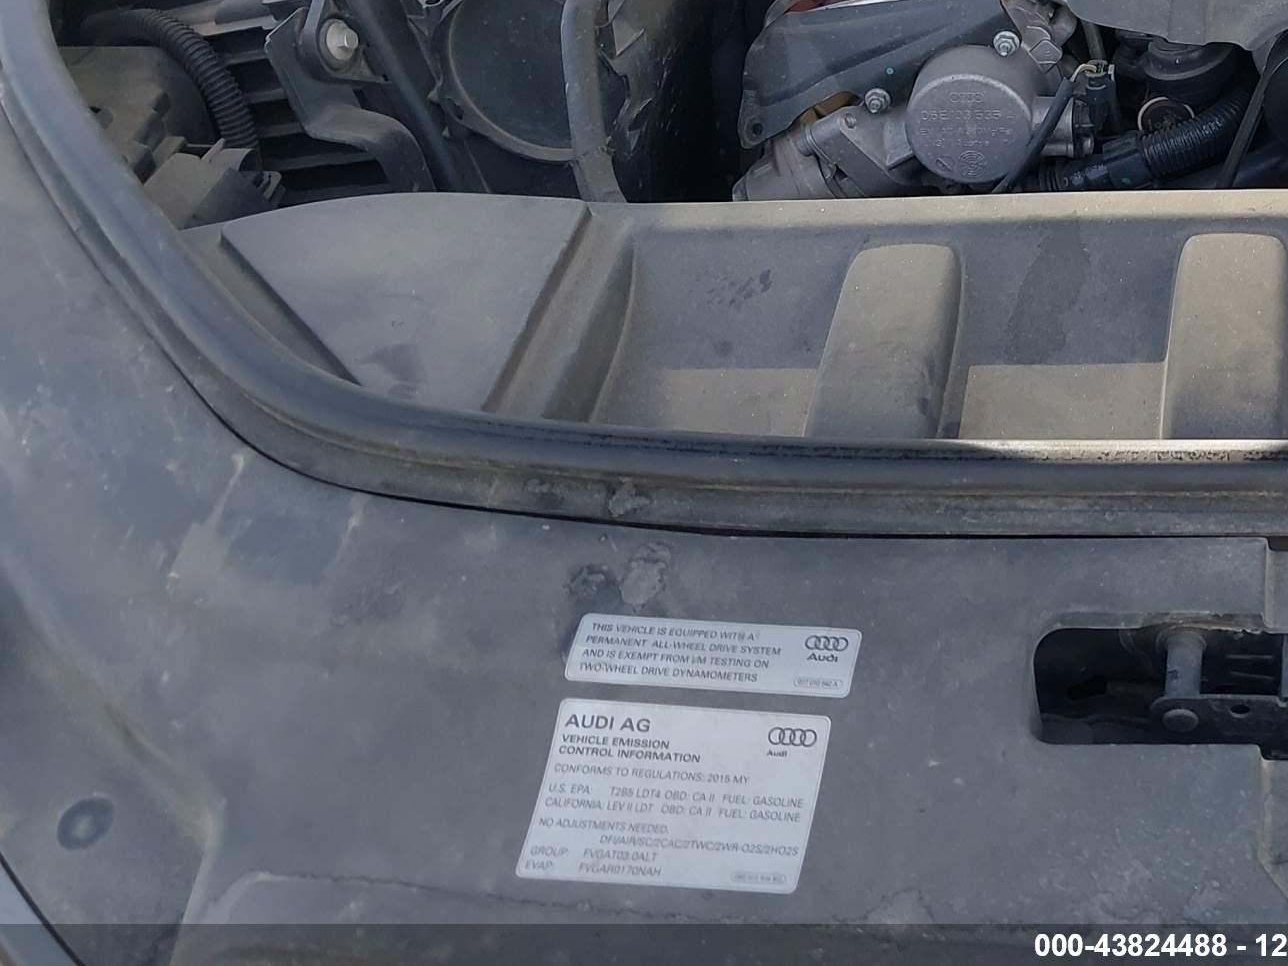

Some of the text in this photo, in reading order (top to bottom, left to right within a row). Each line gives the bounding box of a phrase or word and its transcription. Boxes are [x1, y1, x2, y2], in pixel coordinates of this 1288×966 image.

[592, 622, 614, 632] THIS
[616, 624, 656, 635] VEHICLE
[657, 627, 667, 636] IS
[669, 628, 718, 639] EQUIPPED
[720, 632, 747, 641] WITH
[585, 635, 782, 656] PERMANENT ALL-WHEEL DRIVE SYSTEM
[583, 649, 604, 659] AND
[606, 650, 616, 659] IS
[618, 651, 658, 662] EXEMPT
[660, 653, 689, 664] FROM
[709, 655, 752, 667] TESTING
[753, 659, 769, 669] ON
[807, 653, 838, 663] Audi
[580, 662, 758, 682] TWO-WHEEL DRIVE DYNAMOMETERS
[565, 714, 651, 732] AUDI AG
[562, 734, 670, 749] VEHICLE EMISSION
[558, 745, 701, 763] CONTROL INFORMATION
[766, 749, 787, 757] Audi
[554, 763, 613, 776] CONFORMS
[615, 766, 629, 777] TO
[631, 768, 706, 782] REGULATIONS:
[733, 775, 750, 785] MY
[692, 792, 706, 802] CA
[752, 795, 805, 808] GASOLINE
[606, 800, 626, 811] LEV
[634, 802, 653, 812] LDT
[689, 806, 702, 816] CA
[749, 809, 801, 822] GASOLINE
[540, 817, 554, 828] NO
[556, 818, 626, 832] ADJUSTMENTS
